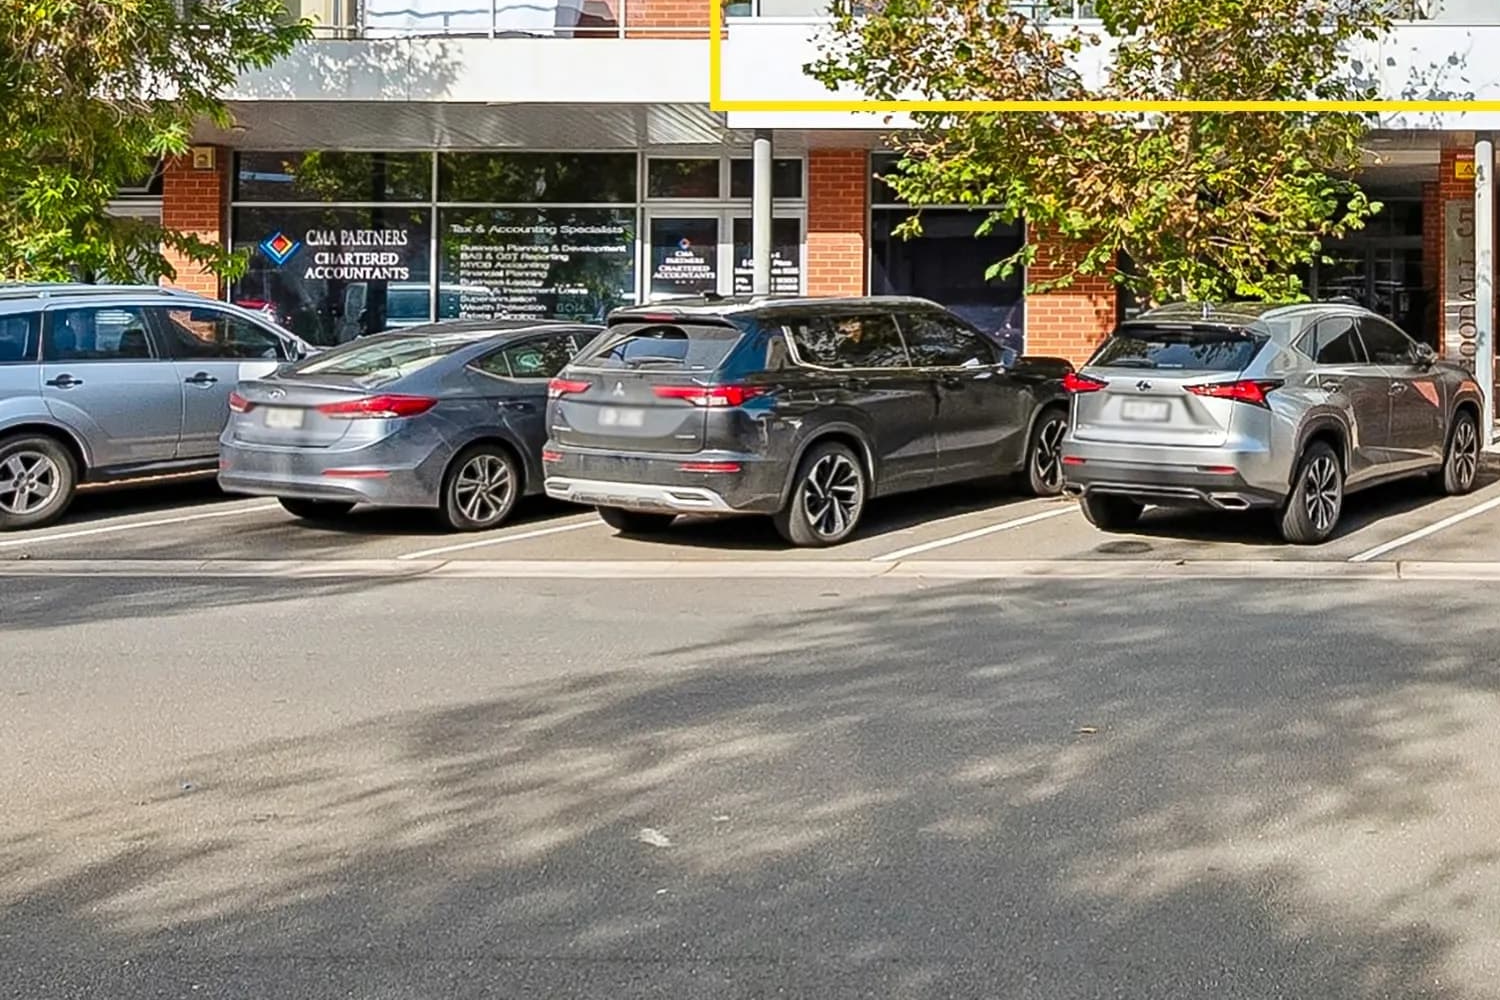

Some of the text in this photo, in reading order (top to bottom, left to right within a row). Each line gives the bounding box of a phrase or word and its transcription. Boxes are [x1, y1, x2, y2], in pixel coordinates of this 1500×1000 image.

[450, 224, 624, 236] Tax & Accounting Specialists
[306, 229, 408, 246] CMA PARTNERS
[460, 244, 626, 253] Business Planning & Development
[314, 252, 399, 266] CHARTERED
[520, 253, 569, 262] Reporting
[494, 261, 550, 270] Accounting
[304, 266, 409, 280] ACCOUNTANTS
[460, 269, 548, 279] Financial Planning
[460, 295, 537, 303] Superannuation
